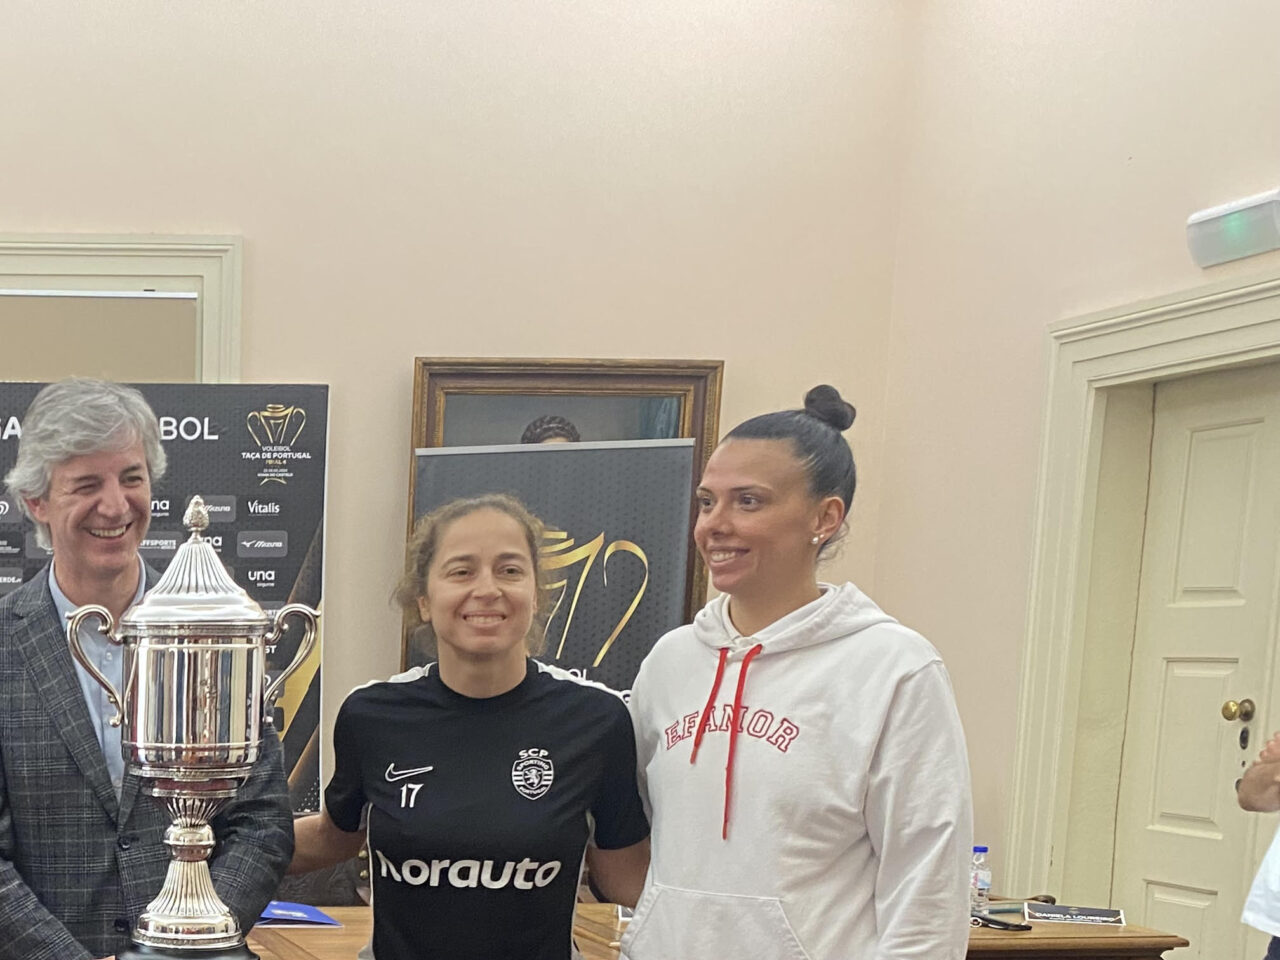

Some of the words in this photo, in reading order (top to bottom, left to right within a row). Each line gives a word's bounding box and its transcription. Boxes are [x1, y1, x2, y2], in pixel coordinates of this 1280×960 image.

[241, 452, 261, 460] TAÇA
[151, 500, 170, 510] na
[248, 500, 280, 513] Vitalis
[248, 570, 275, 580] una
[664, 704, 800, 752] EFANOR
[519, 748, 549, 759] SCP
[400, 783, 424, 808] 17
